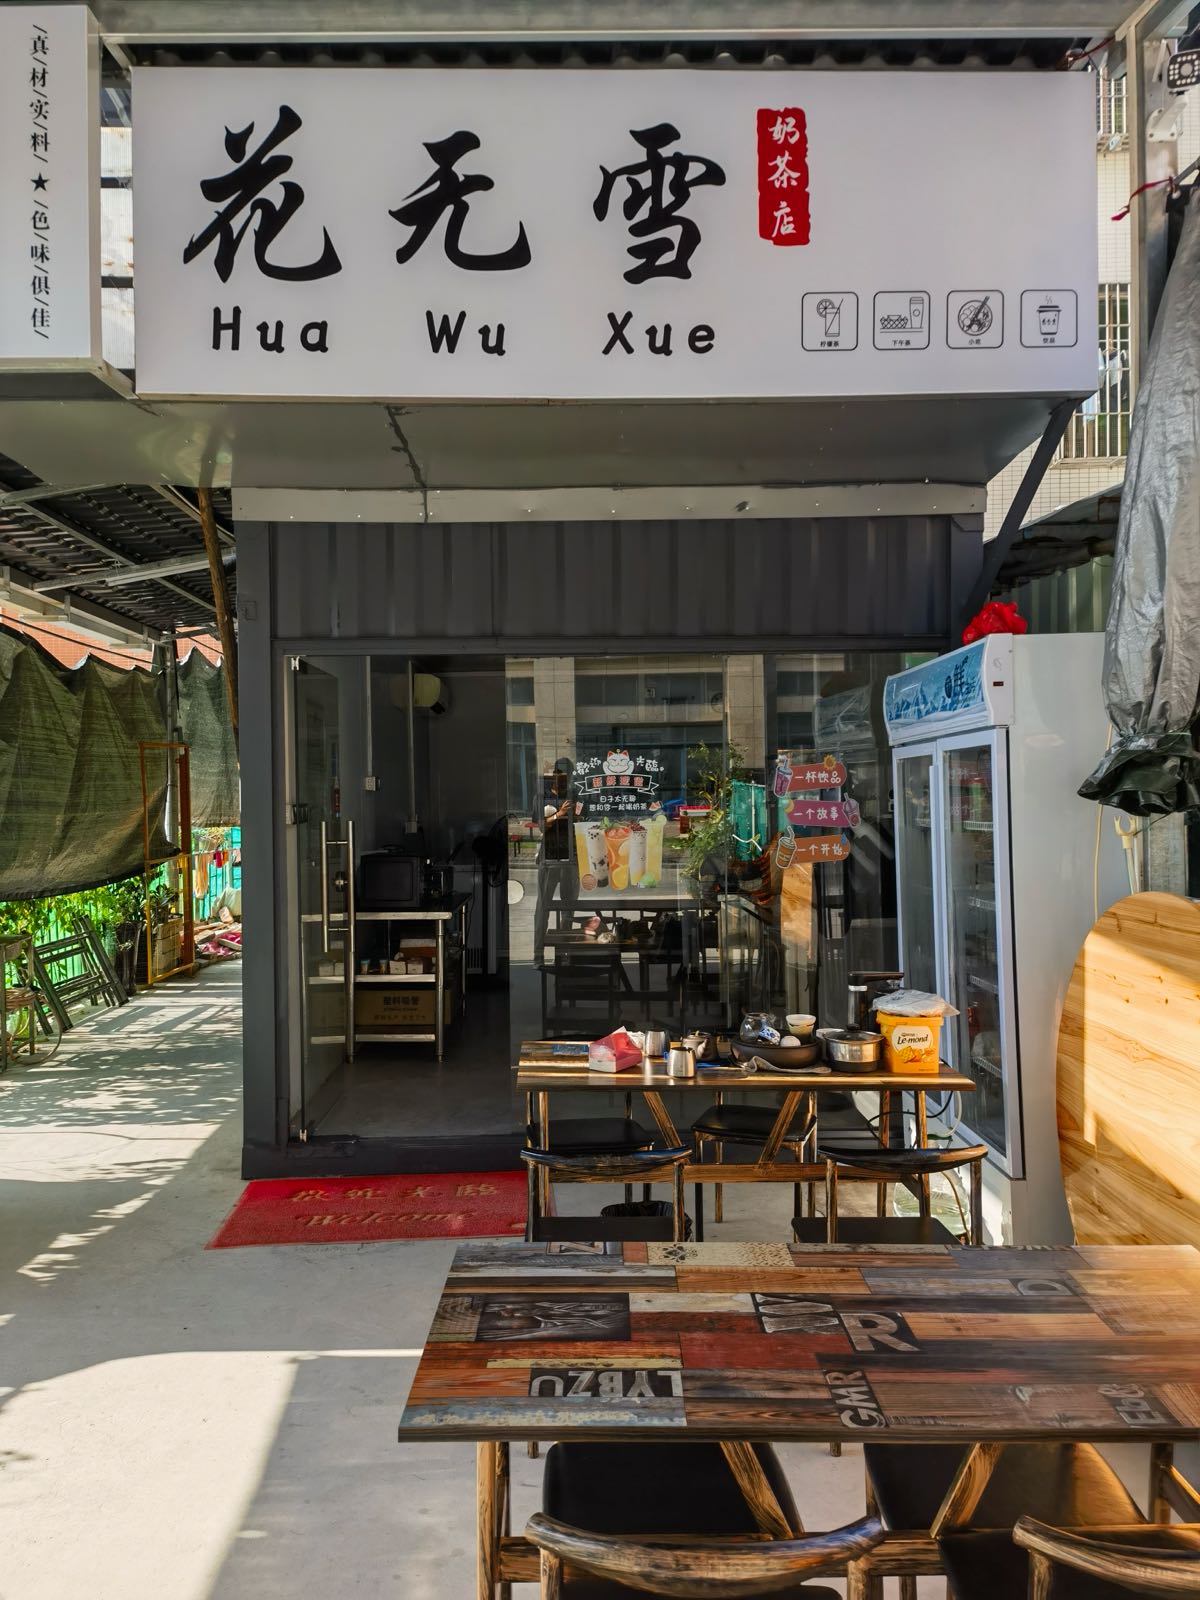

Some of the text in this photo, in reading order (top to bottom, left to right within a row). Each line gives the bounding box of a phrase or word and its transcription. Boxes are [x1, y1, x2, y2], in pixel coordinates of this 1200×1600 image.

[767, 116, 802, 239] 奶茶店
[183, 105, 726, 284] 花无雪
[213, 306, 714, 356] Hua Wu Xue
[794, 770, 842, 784] 一杯饮品
[589, 803, 648, 812] 想和你一起喝奶茶
[599, 794, 637, 803] 日子太无聊
[793, 806, 839, 821] 一个故事
[300, 1208, 475, 1227] Welcome
[839, 1312, 920, 1352] R
